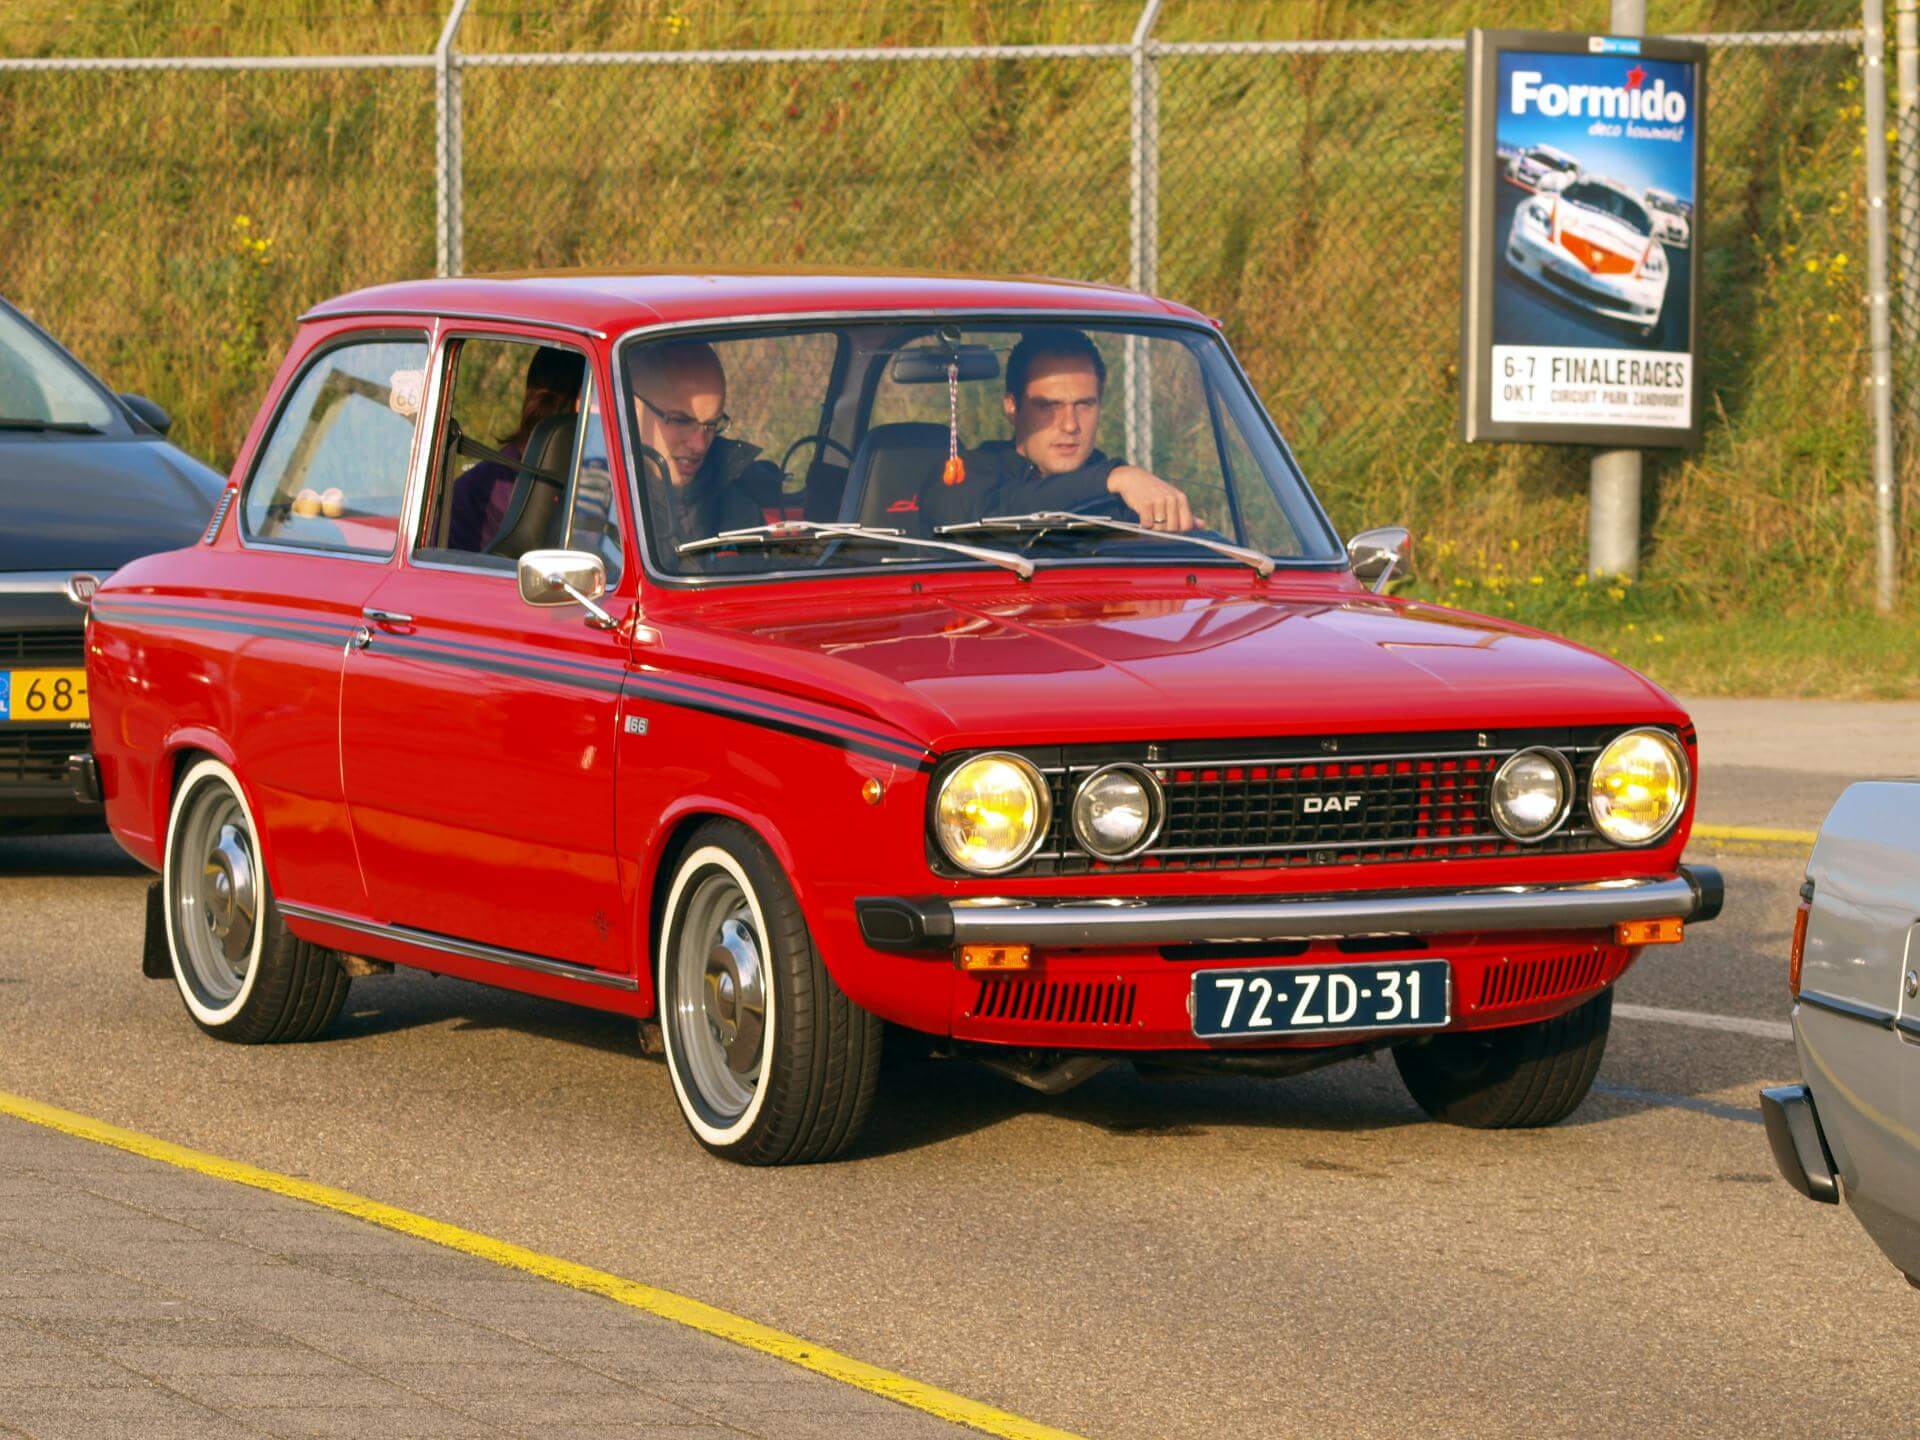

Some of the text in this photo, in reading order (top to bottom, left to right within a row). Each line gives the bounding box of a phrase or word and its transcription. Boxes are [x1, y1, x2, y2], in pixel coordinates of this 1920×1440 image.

[1511, 66, 1686, 123] Formido
[1503, 384, 1535, 402] OKT
[1303, 795, 1362, 813] DAF
